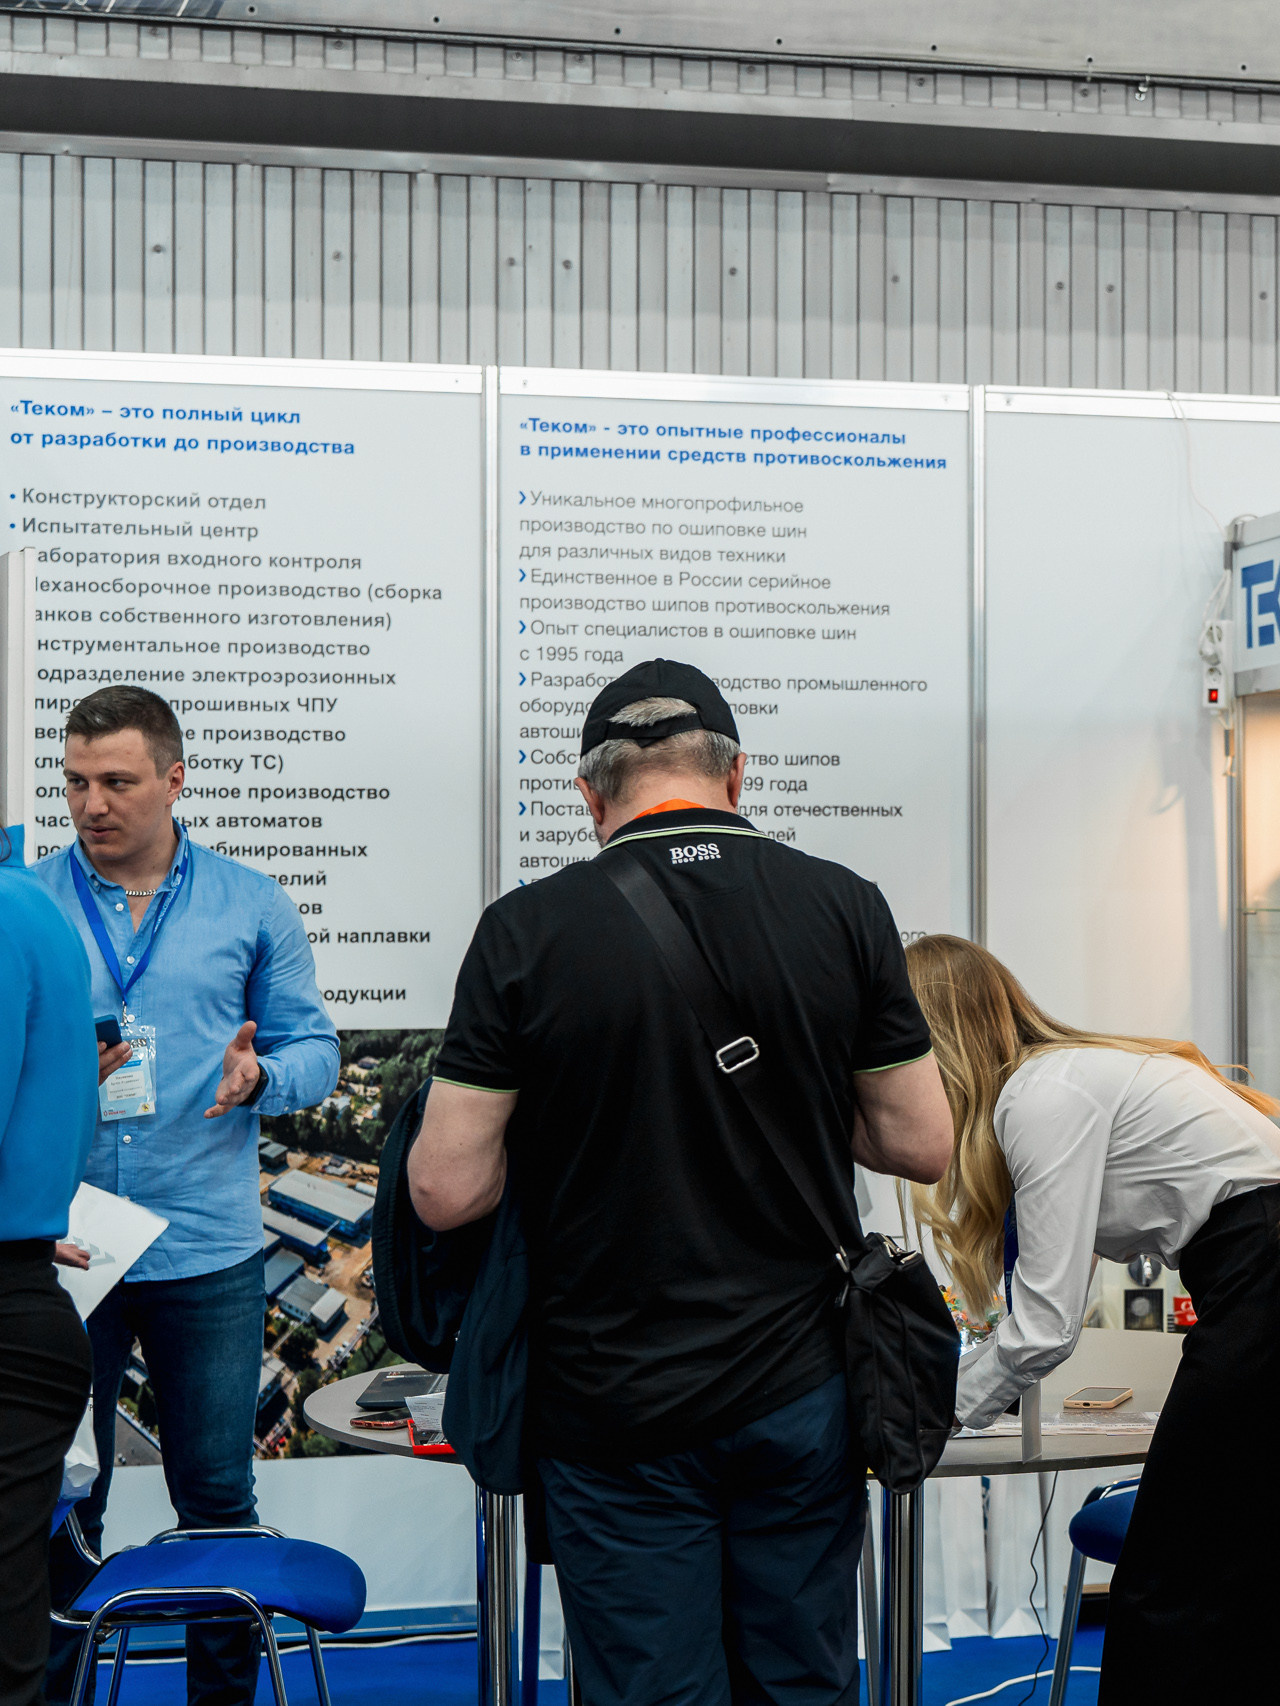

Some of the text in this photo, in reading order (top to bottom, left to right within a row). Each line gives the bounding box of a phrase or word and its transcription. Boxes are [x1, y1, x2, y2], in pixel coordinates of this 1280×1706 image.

[10, 399, 94, 416] «Теком»
[119, 406, 154, 419] это
[162, 407, 242, 421] полный
[250, 411, 300, 425] цикл
[519, 417, 596, 433] «Теком»
[617, 423, 649, 436] это
[655, 425, 743, 439] опытные
[750, 426, 905, 444] профессионалы
[10, 431, 354, 455] от разработки до производства
[520, 444, 946, 469] в применении средств противоскольжения
[22, 487, 266, 511] Конструкторский отдел
[529, 489, 803, 514] Уникальное многопрофильное
[22, 516, 258, 542] Испытательный центр
[519, 519, 807, 538] производство по ошиповке шин
[37, 547, 361, 572] аборатория входного контроля
[518, 545, 785, 563] для различных видов техники
[33, 575, 442, 603] еханосборочное производство (сборка
[530, 567, 831, 591] Единственное в России серийное
[519, 597, 890, 616] производство шипов противоскольжения
[33, 606, 391, 631] анков собственного изготовления)
[530, 619, 856, 640] Опыт специалистов в ошиповке шин
[36, 637, 370, 657] нструментальное производство
[519, 645, 623, 664] с 1995 года
[36, 666, 395, 687] одразделение электроэрозионных
[786, 678, 928, 693] промышленного
[297, 697, 337, 712] ЧПУ
[203, 728, 346, 744] производство
[250, 754, 283, 774] ТС)
[784, 754, 840, 766] шипов
[248, 787, 390, 802] производство
[743, 776, 808, 794] 99 года
[773, 804, 903, 817] отечественных
[215, 815, 322, 828] автоматов
[519, 826, 599, 846] и зарубе
[209, 840, 368, 861] бинированных
[669, 843, 720, 860] BOSS
[268, 870, 327, 886] елий
[337, 930, 430, 943] наплавки
[321, 988, 407, 1004] одукции
